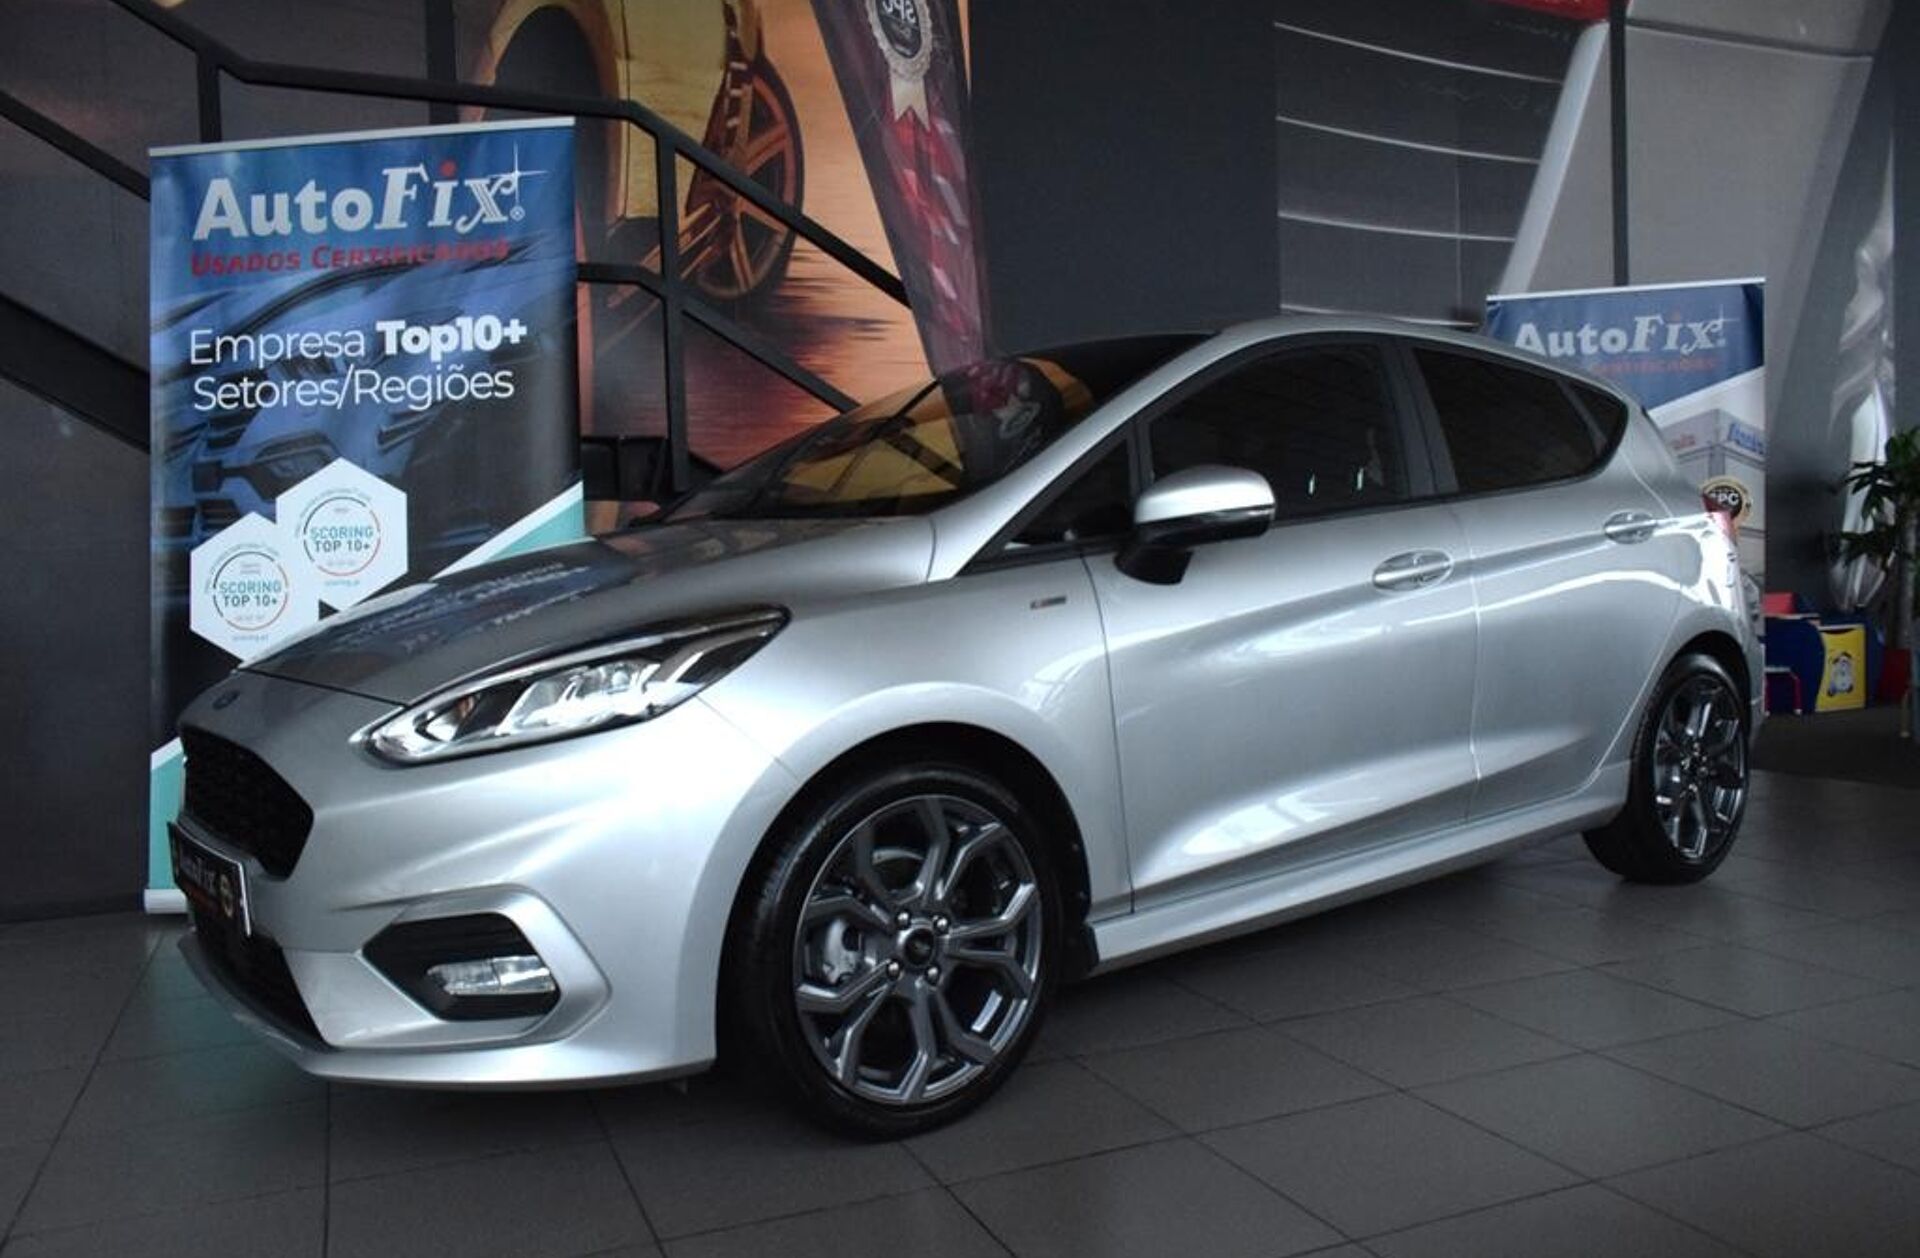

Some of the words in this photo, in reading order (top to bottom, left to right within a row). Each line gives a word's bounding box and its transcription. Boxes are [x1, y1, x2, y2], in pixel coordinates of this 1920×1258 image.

[190, 329, 365, 369] Empresa
[375, 315, 528, 361] Top10+
[193, 363, 515, 411] Setores/Regiões
[310, 525, 374, 540] SCORING
[314, 539, 342, 552] TOP
[347, 539, 370, 551] 10+
[219, 580, 282, 594] SCORING
[222, 594, 250, 607] TOP
[255, 593, 278, 607] 10+
